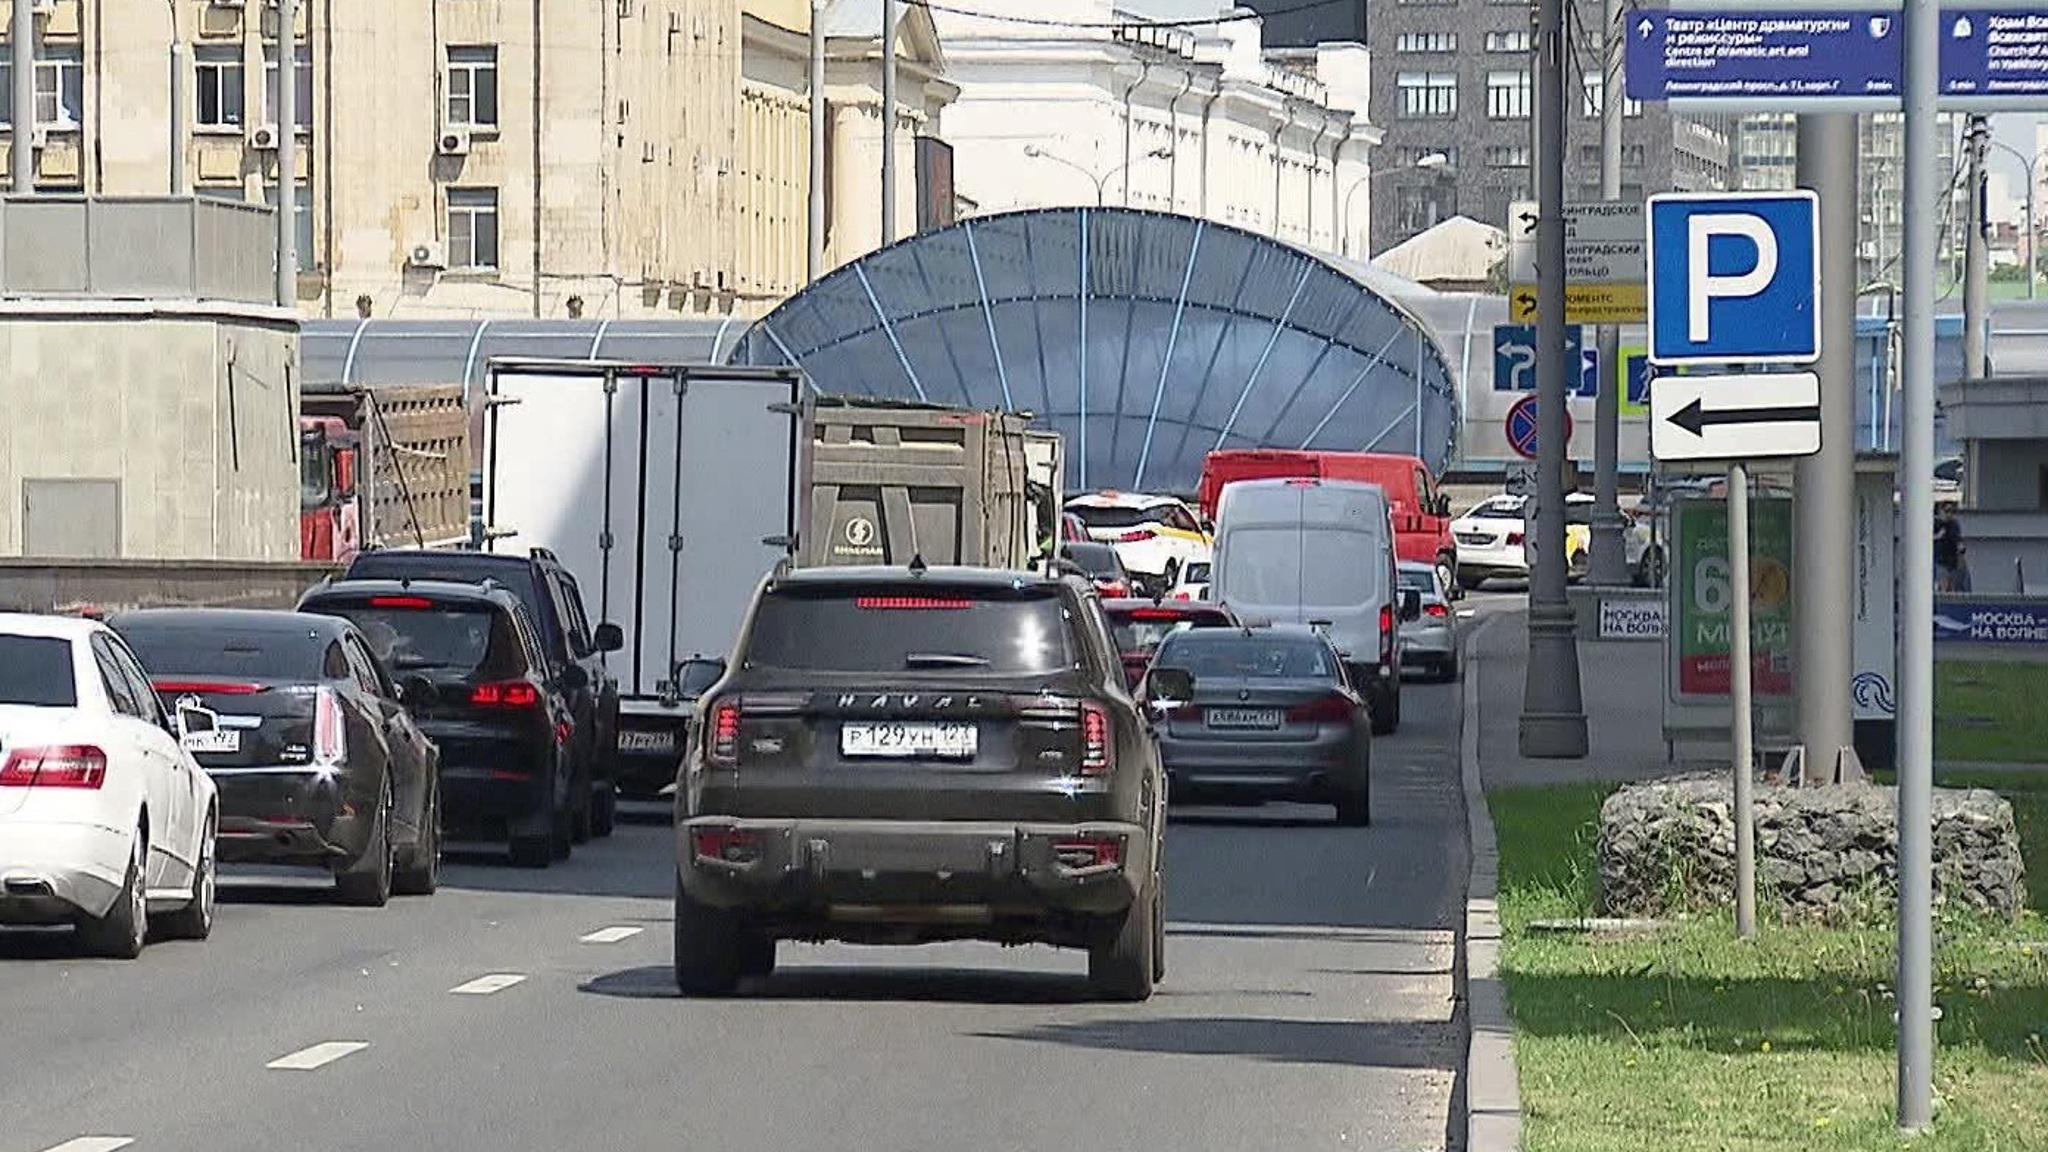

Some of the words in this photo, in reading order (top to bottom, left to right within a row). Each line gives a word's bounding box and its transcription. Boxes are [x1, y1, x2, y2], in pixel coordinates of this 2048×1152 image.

[1664, 18, 1704, 33] Театр
[1760, 19, 1850, 33] драматургии
[1703, 44, 1717, 57] of
[1664, 57, 1717, 68] direction
[1562, 205, 1638, 217] ИНГРАДСКОЕ
[1688, 213, 1778, 343] P
[1972, 612, 2035, 625] МОСКВА
[1603, 623, 1624, 633] НА
[1971, 627, 1994, 638] НА
[837, 695, 982, 708] HAVAL
